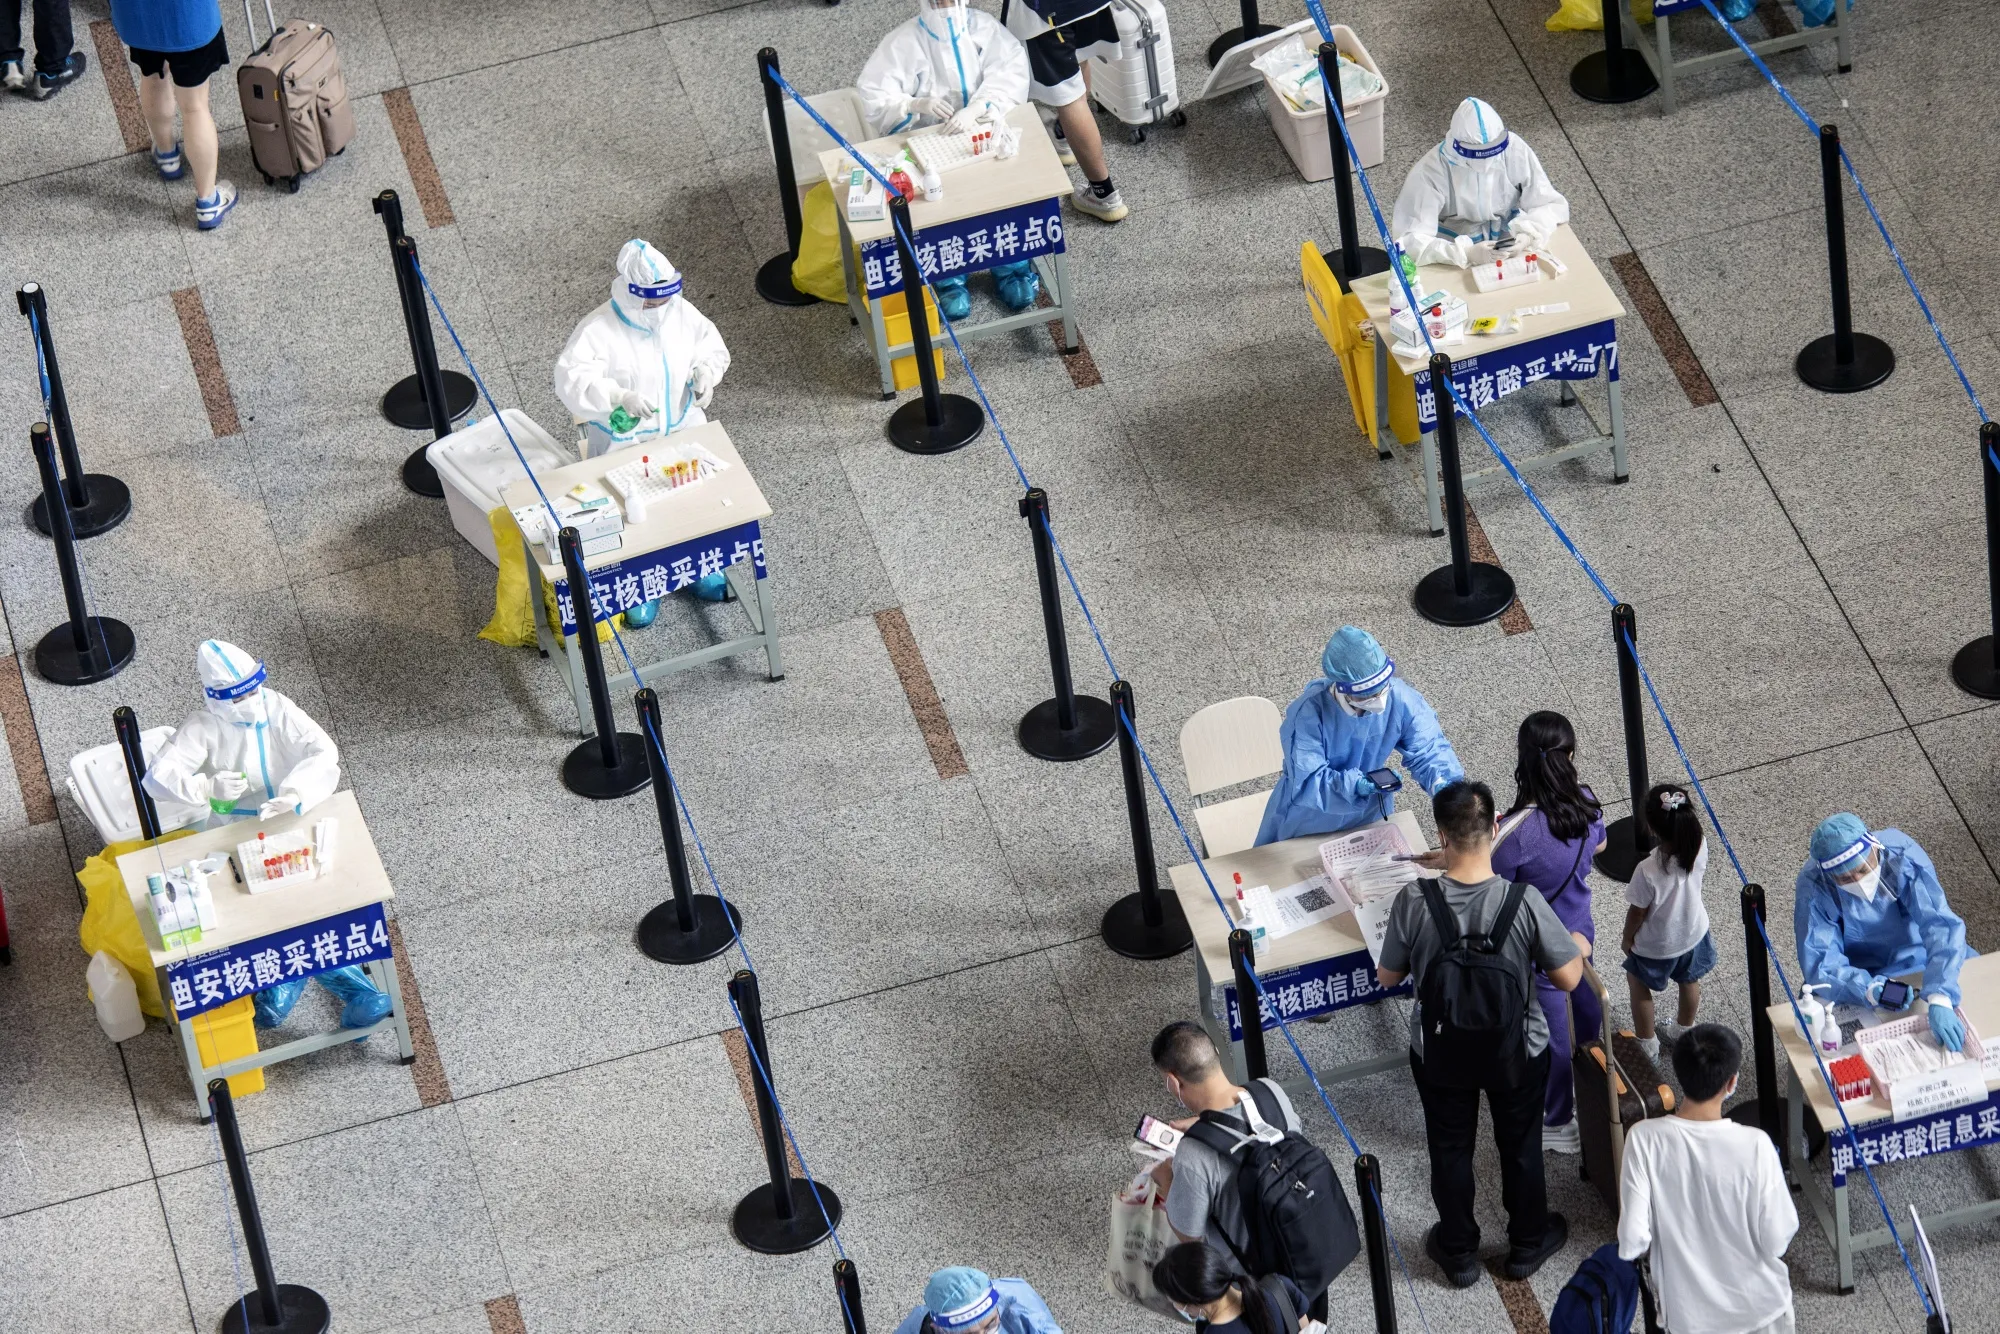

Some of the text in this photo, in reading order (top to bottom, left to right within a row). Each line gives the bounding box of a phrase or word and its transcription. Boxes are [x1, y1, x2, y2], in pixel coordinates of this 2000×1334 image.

[170, 919, 390, 1011] 迪安核酸采样点4
[1230, 967, 1414, 1030] 安核酸信息
[1831, 1106, 2000, 1177] 迪安核酸信息采
